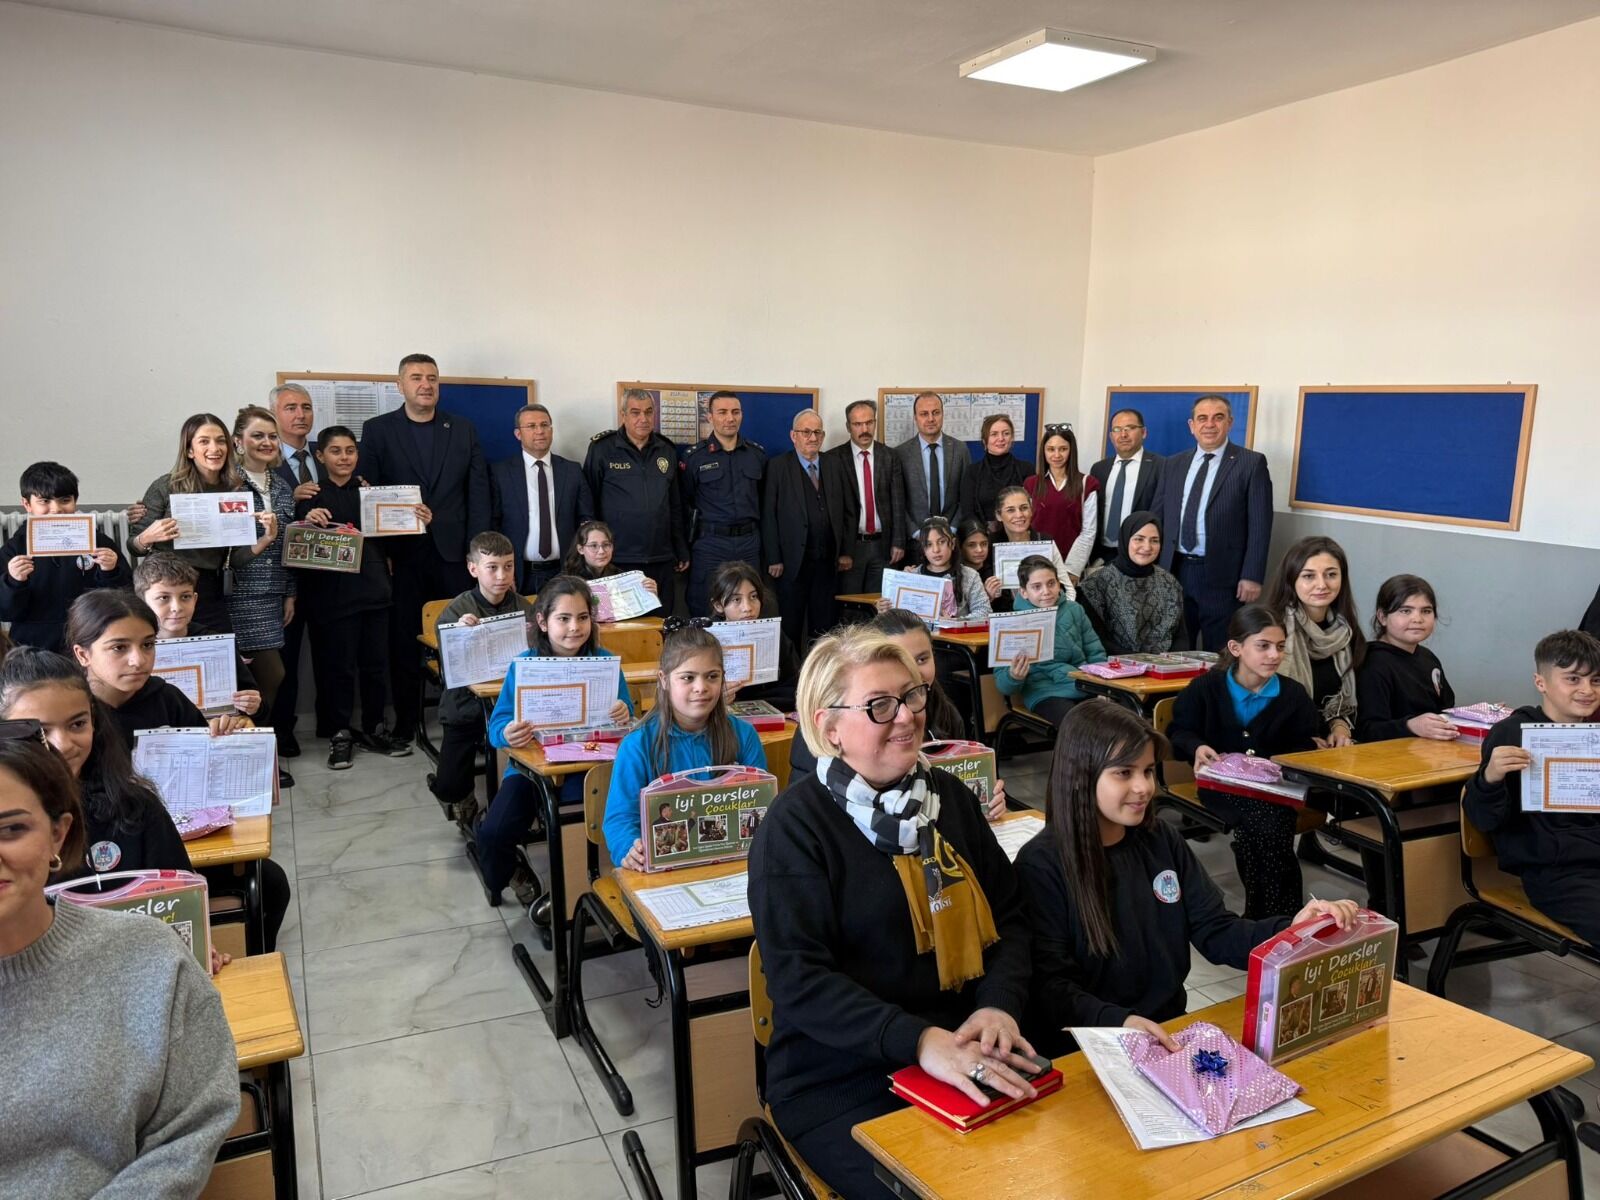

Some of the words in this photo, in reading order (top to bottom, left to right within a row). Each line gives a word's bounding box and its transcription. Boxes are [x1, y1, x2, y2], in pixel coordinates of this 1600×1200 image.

[701, 787, 760, 806] Dersler
[705, 799, 757, 816] Çocuklar!
[1328, 941, 1382, 972] Dersler
[1330, 954, 1378, 984] Çocuklar!
